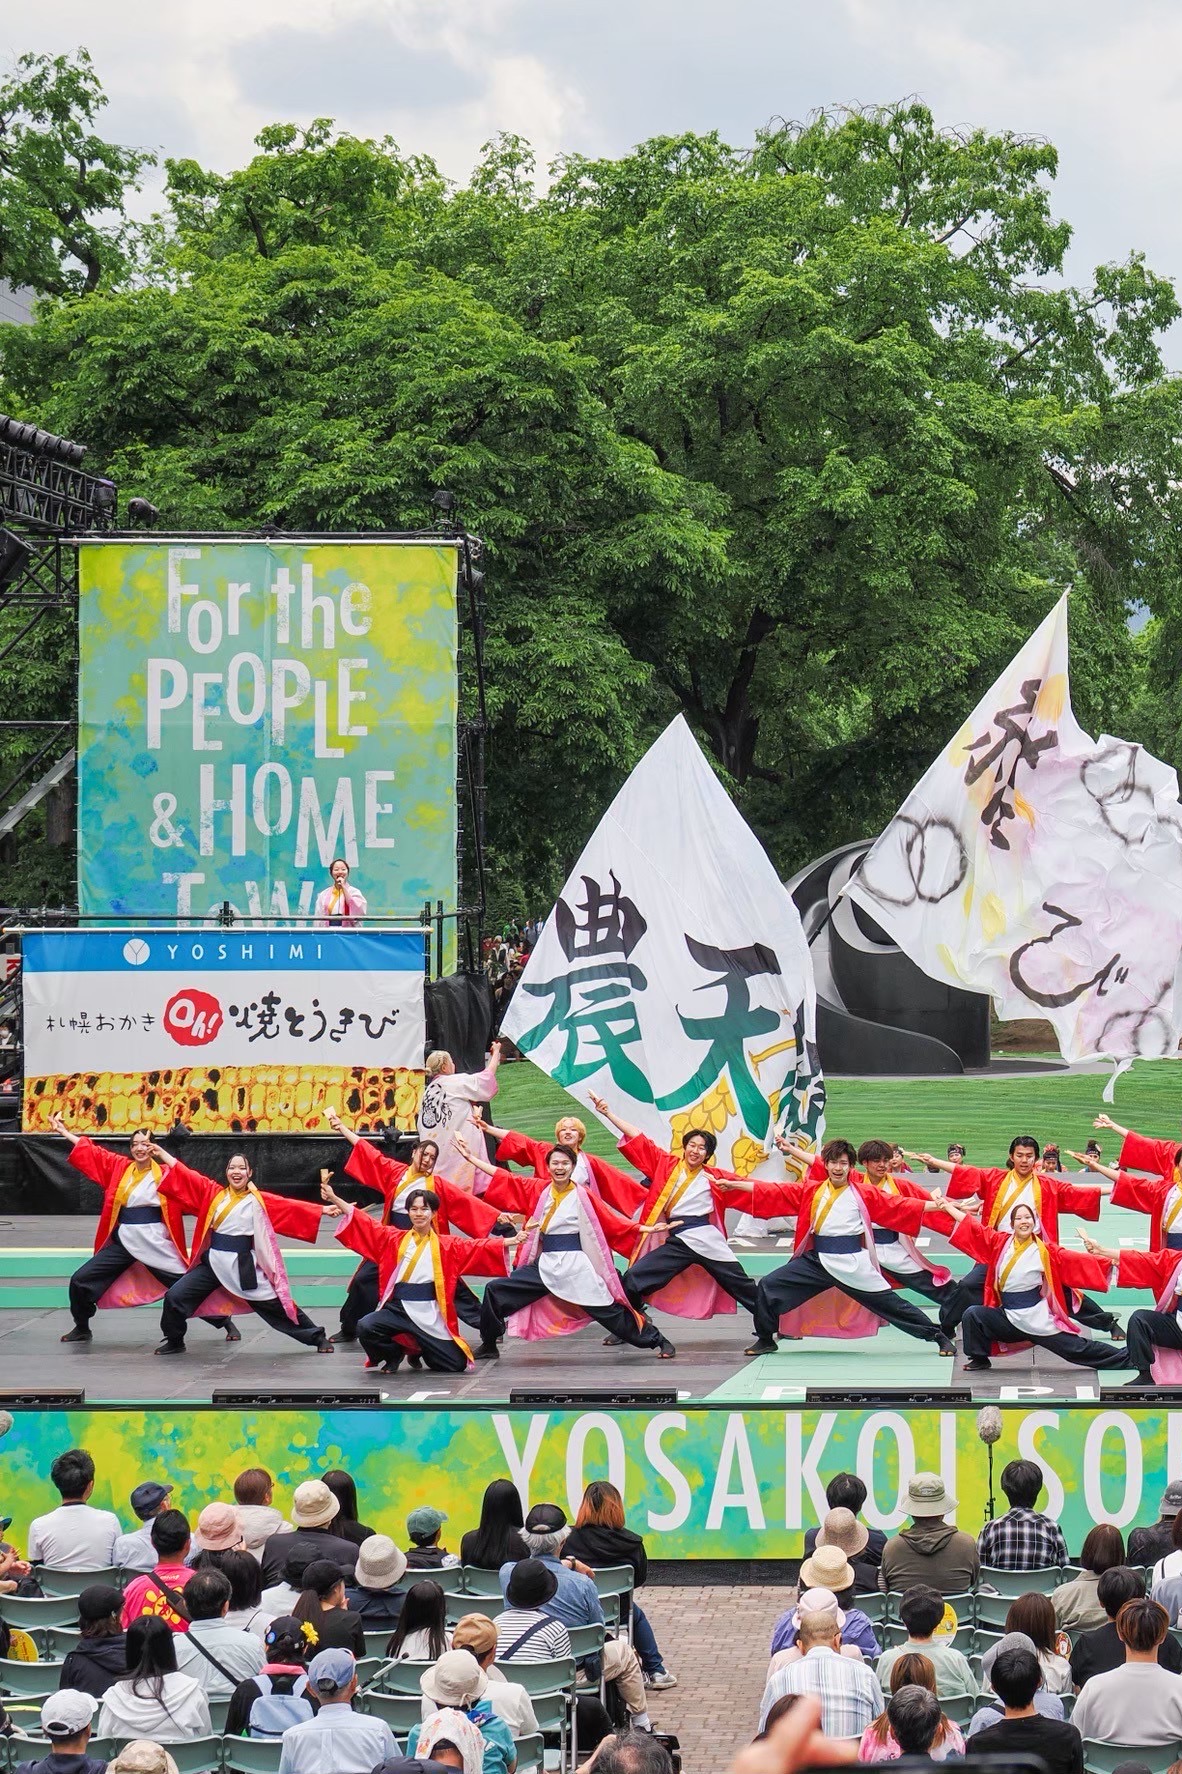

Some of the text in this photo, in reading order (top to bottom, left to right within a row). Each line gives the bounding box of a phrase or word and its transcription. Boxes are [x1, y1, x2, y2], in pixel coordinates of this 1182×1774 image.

[167, 548, 374, 654] For the
[146, 651, 369, 759] PEOPLE
[149, 762, 395, 868] & HOME
[167, 944, 323, 960] YOSHIMI
[46, 991, 400, 1042] 札幌おかき Oh! 焼とうきび
[491, 1411, 957, 1530] YOSAKOI
